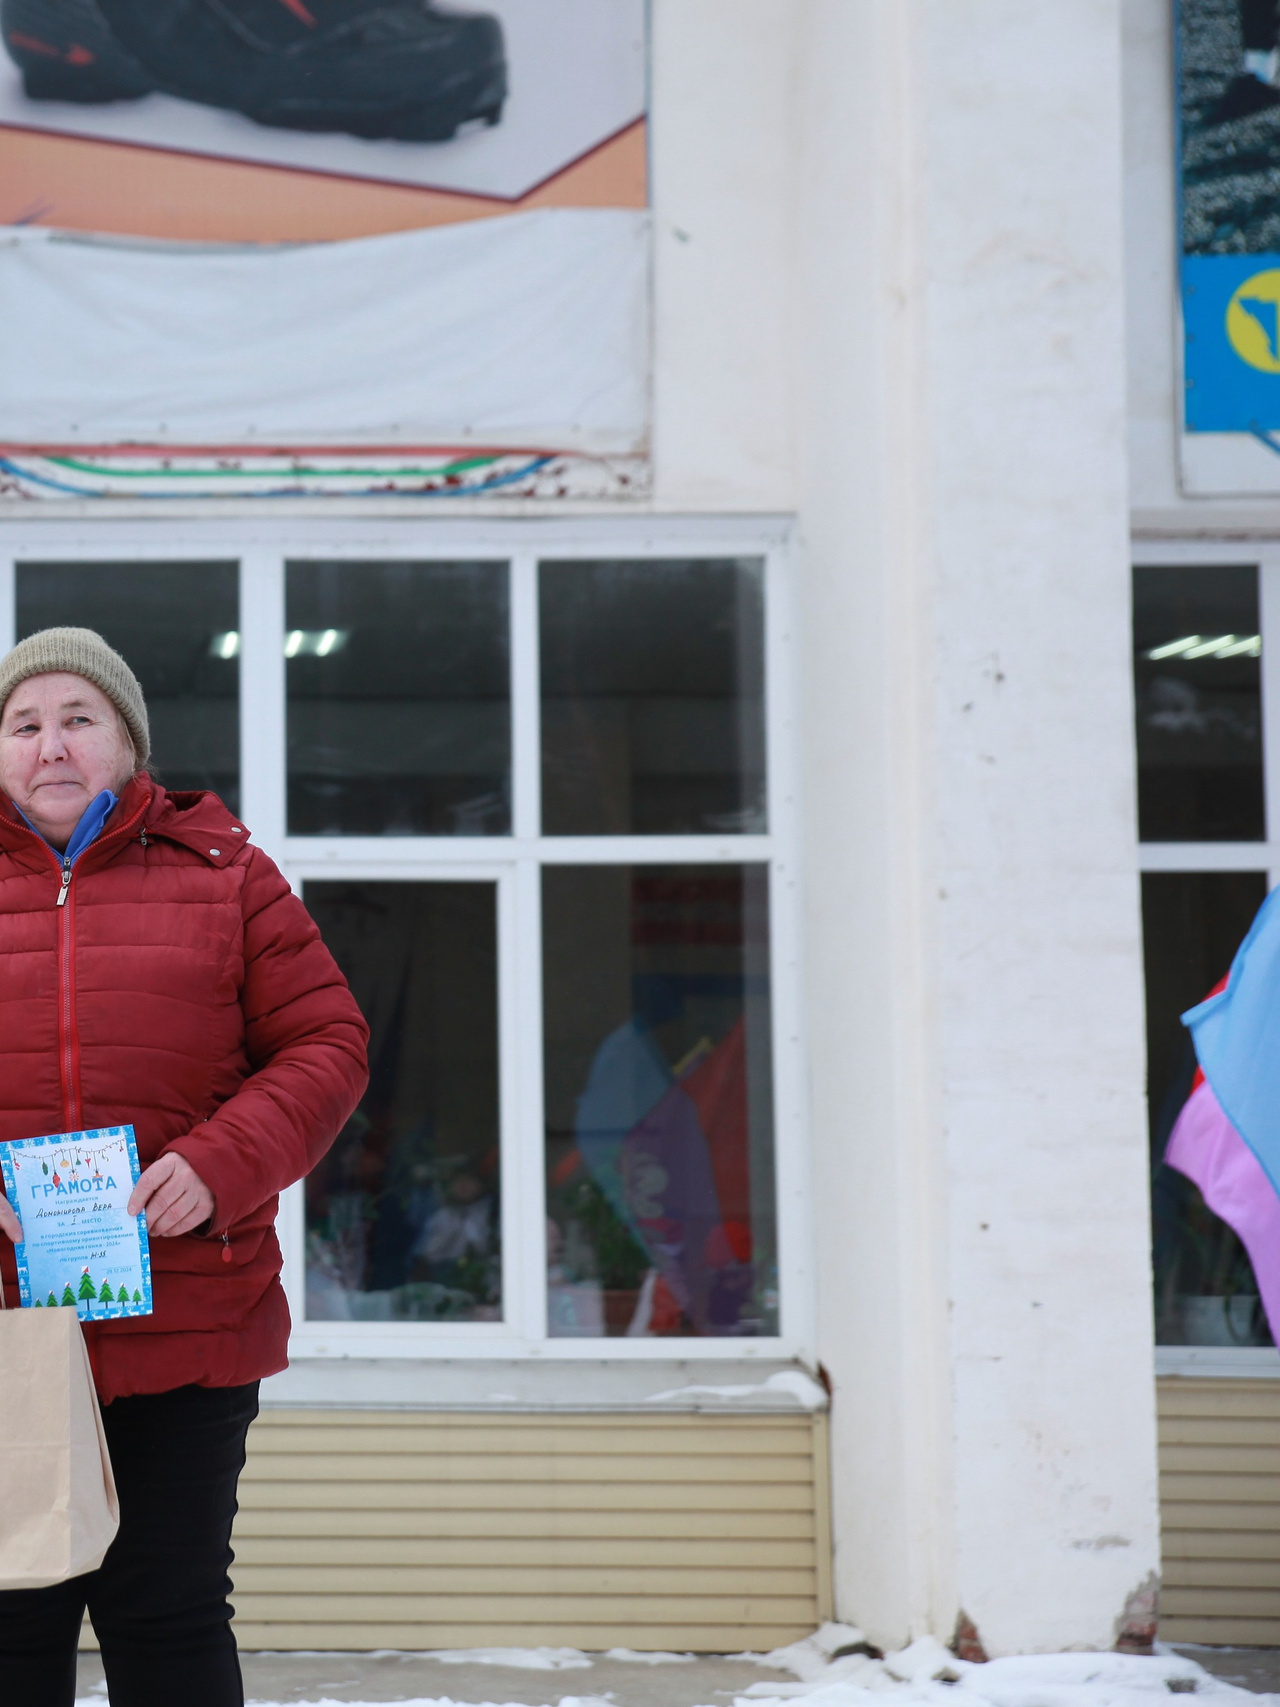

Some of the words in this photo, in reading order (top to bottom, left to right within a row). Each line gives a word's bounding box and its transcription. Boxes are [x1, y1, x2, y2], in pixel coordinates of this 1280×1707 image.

[31, 1175, 117, 1199] ГРАМОТА
[55, 1196, 99, 1205] Награждается
[81, 1217, 102, 1225] МЕСТО
[40, 1238, 81, 1247] спортивному
[81, 1232, 134, 1243] ориентированию
[67, 1255, 89, 1263] группе
